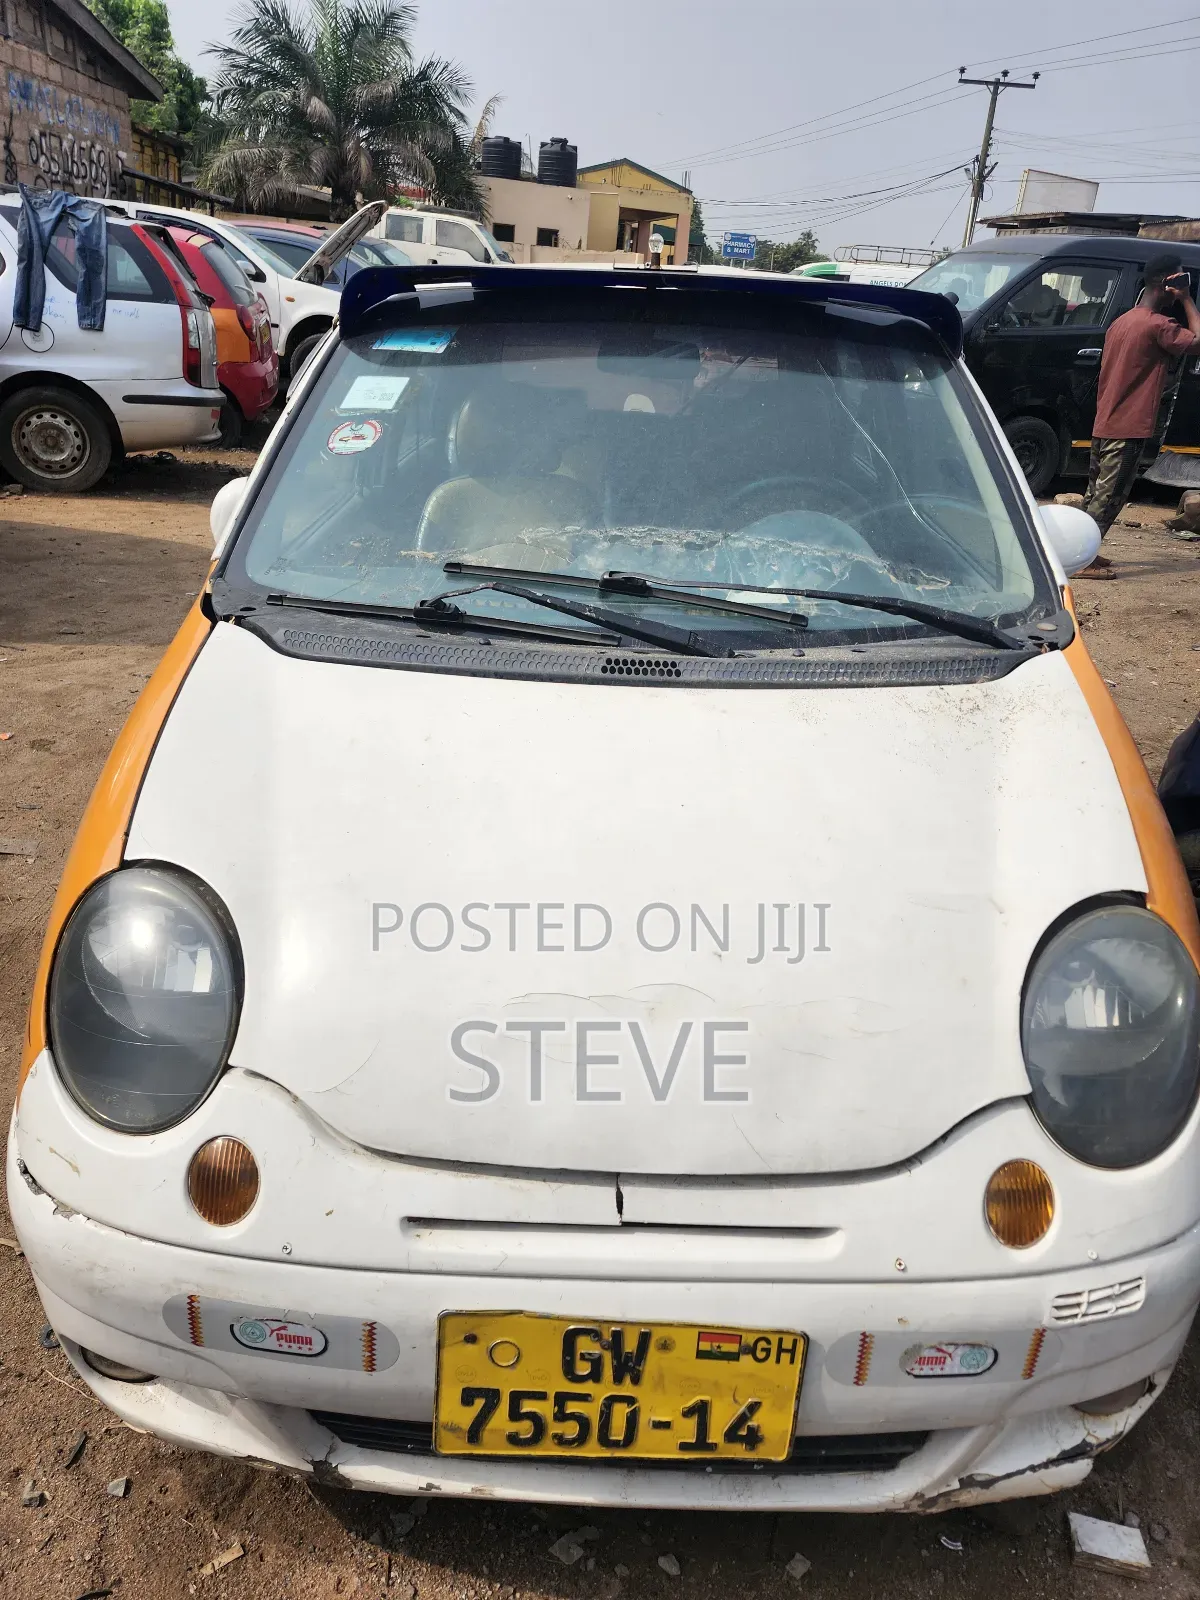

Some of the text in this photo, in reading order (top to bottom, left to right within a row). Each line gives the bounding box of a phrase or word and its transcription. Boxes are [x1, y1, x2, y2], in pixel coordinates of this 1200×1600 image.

[723, 240, 755, 249] PHARMACY
[276, 1332, 313, 1347] PUMA
[562, 1326, 798, 1386] GW GH
[459, 1386, 766, 1452] 7550-14
